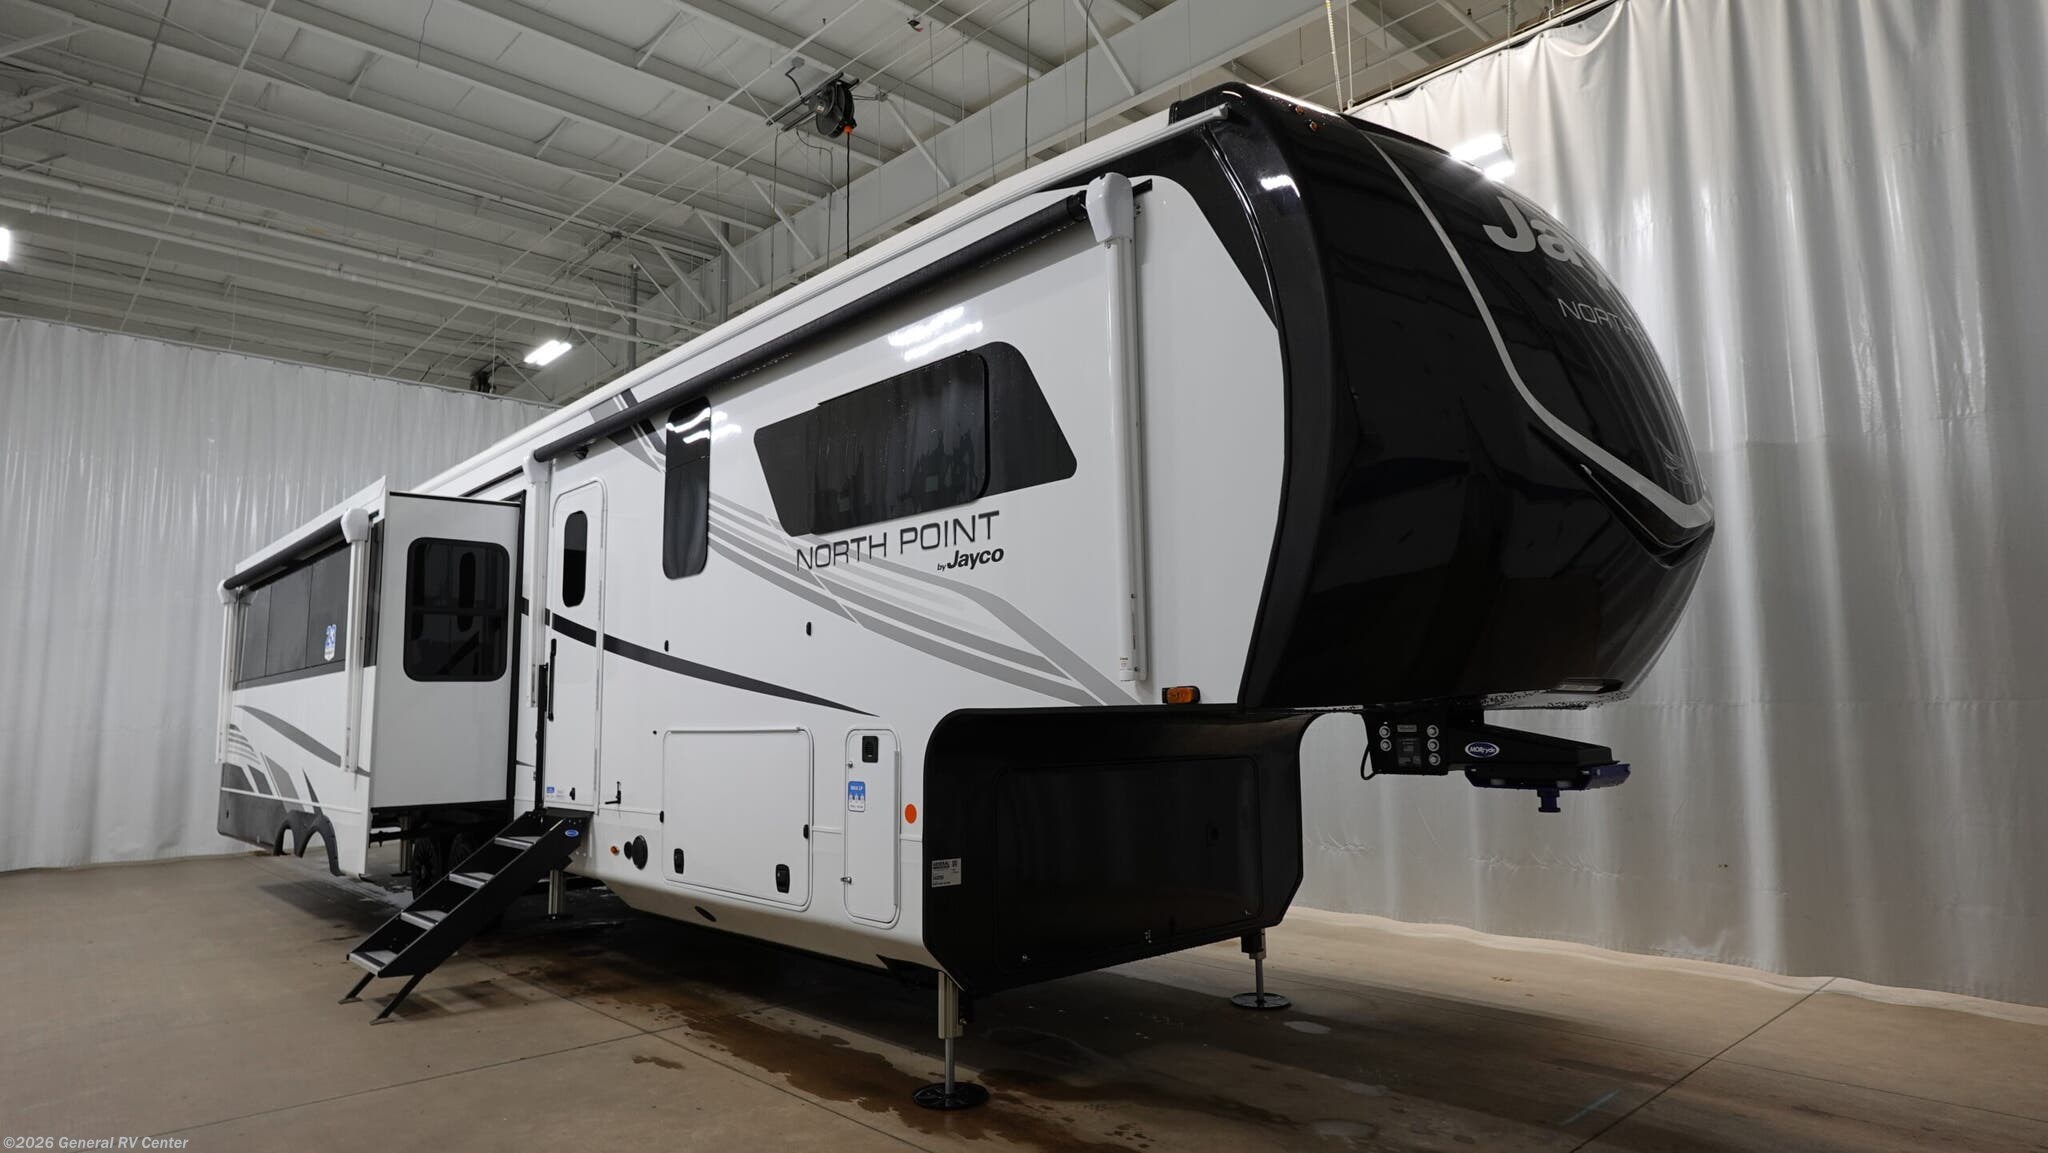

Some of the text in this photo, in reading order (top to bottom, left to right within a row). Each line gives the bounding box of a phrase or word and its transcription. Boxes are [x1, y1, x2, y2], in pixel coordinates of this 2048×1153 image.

[796, 510, 1000, 572] NORTH POINT
[936, 547, 1005, 572] by Jayco
